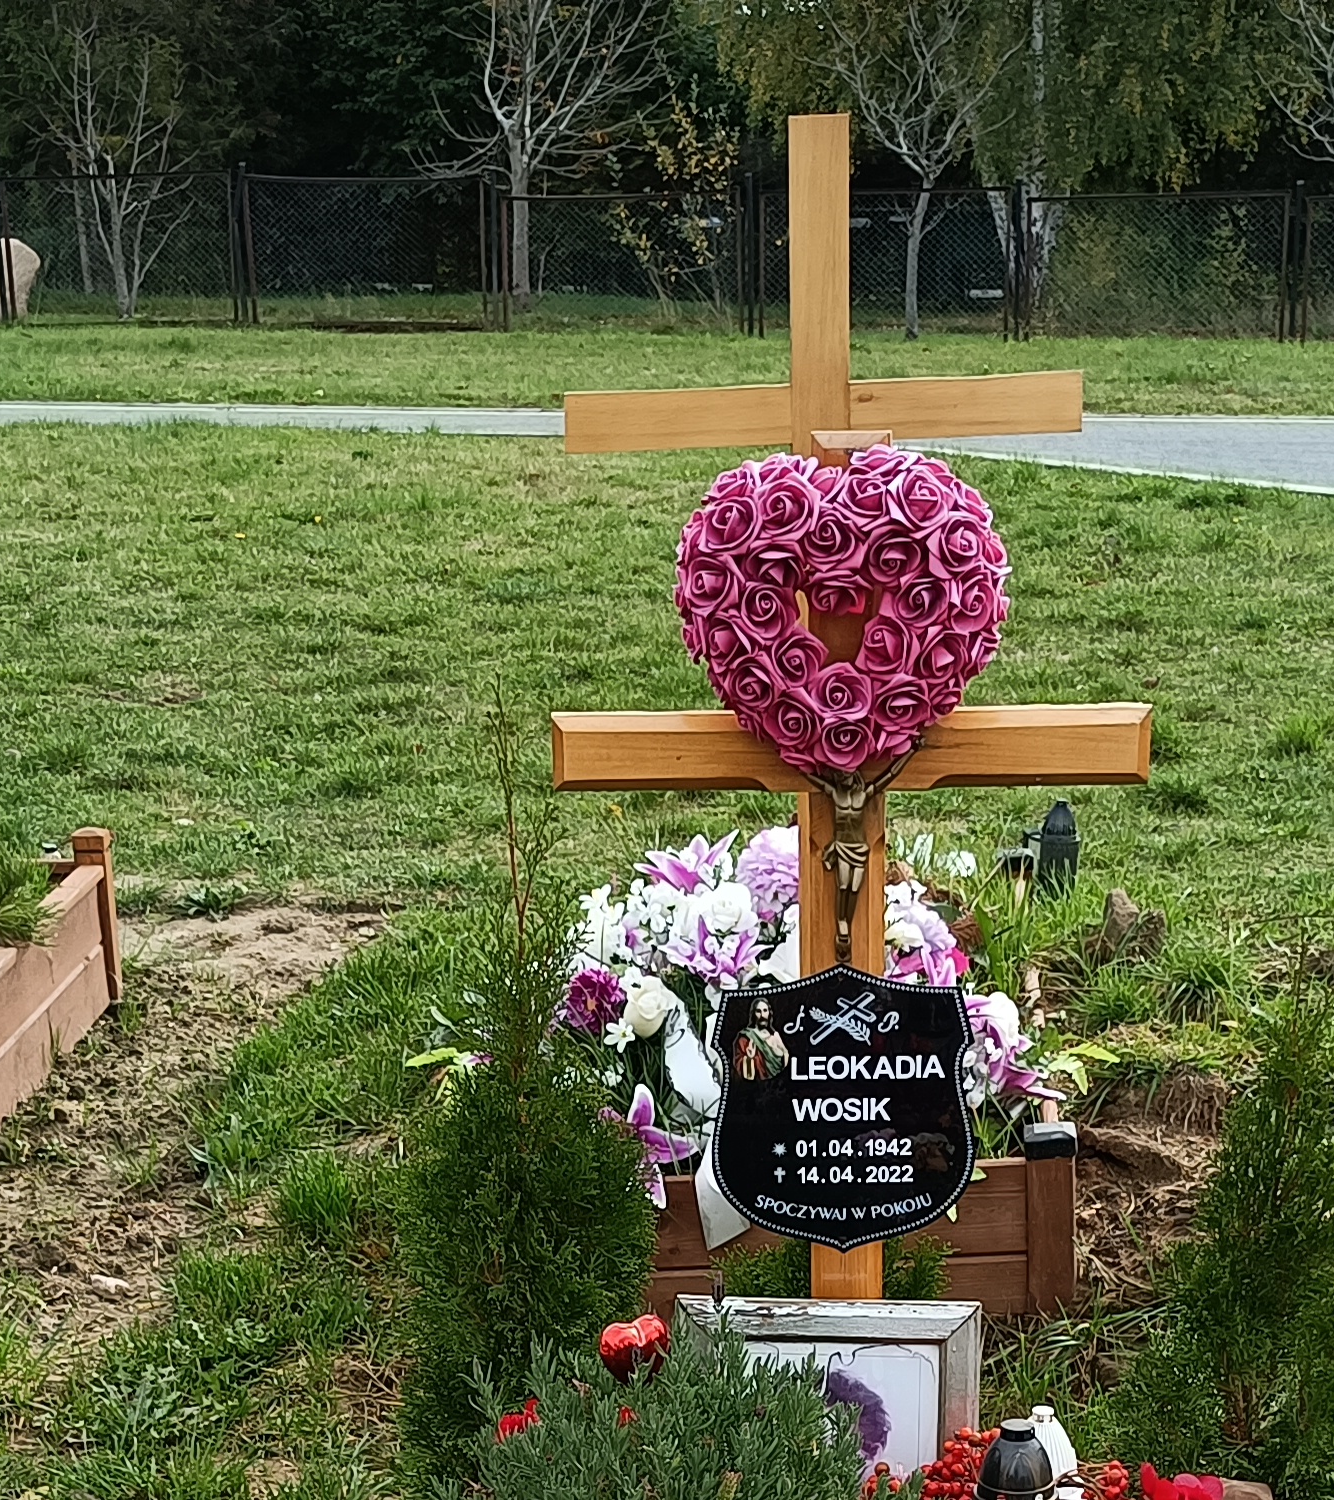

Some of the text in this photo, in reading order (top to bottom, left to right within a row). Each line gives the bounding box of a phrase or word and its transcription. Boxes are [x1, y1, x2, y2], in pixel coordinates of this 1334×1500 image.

[790, 1054, 946, 1081] LEOKADIA
[791, 1097, 892, 1122] WOSIK
[795, 1137, 913, 1158] 01.04.1942
[796, 1164, 914, 1184] 14.04.2022
[754, 1192, 932, 1221] SPOCZYWAJ W POKOJU
